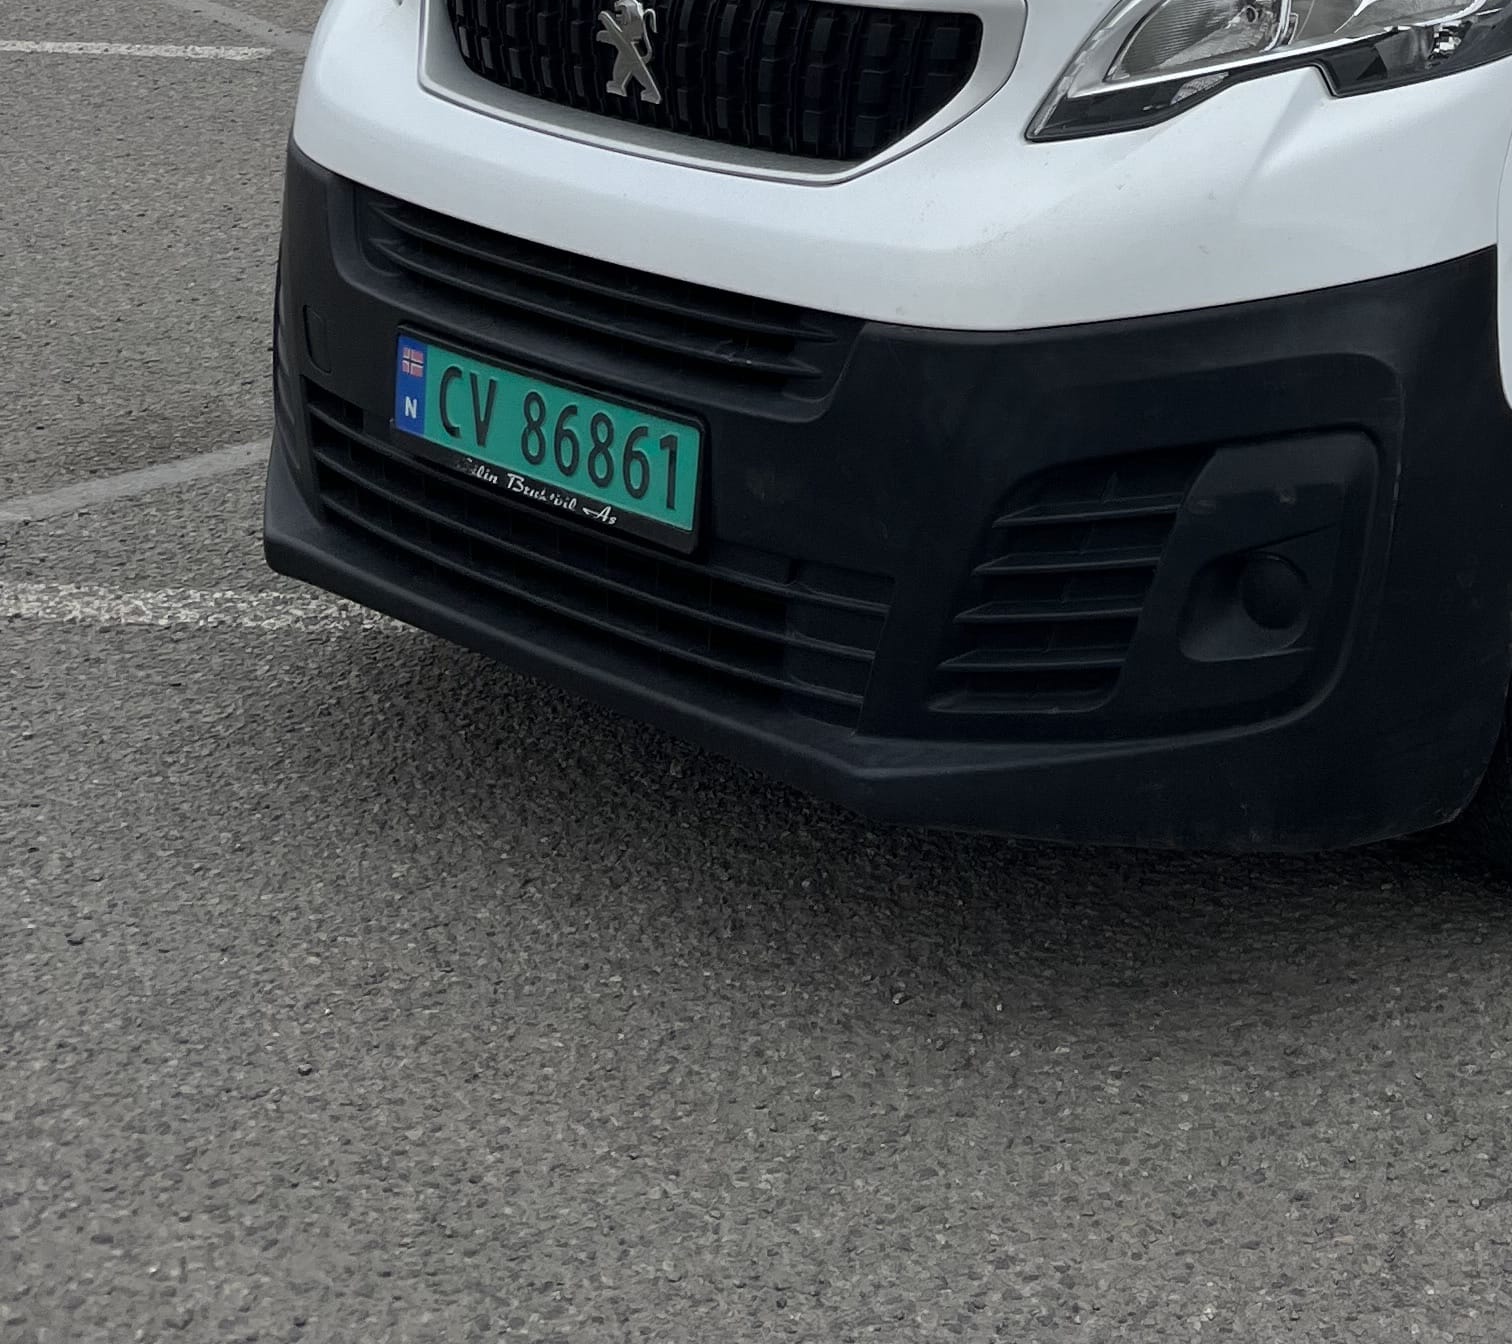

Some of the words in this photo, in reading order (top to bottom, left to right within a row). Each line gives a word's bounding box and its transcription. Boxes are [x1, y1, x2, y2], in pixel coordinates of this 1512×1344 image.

[404, 396, 418, 419] N
[439, 365, 498, 448] CV
[521, 391, 679, 511] 86861
